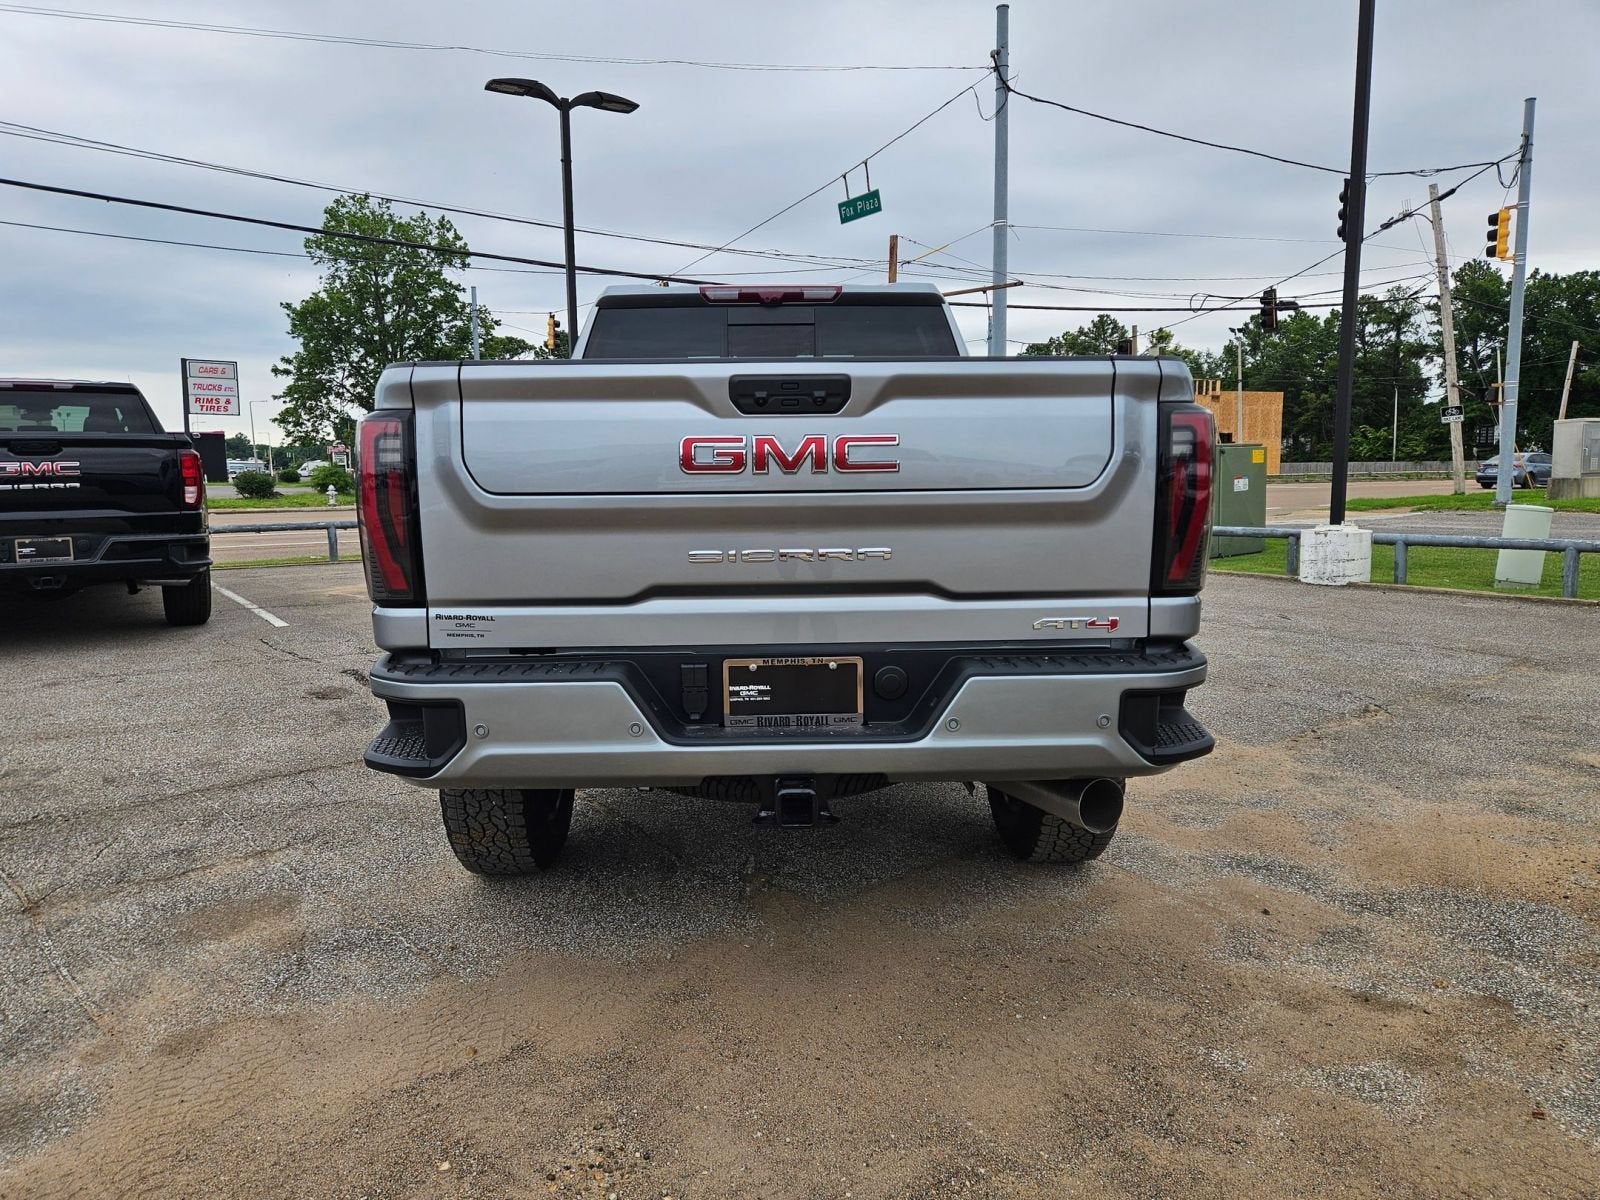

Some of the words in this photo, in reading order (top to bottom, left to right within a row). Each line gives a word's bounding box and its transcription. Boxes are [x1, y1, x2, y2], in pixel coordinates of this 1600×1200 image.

[841, 206, 855, 219] Fox
[856, 198, 879, 214] Plaza
[198, 366, 219, 375] CARS
[192, 383, 223, 392] TRUCKS
[194, 397, 221, 405] RIMS
[199, 405, 229, 413] TIRES
[679, 434, 900, 475] GMC
[0, 461, 81, 476] GMC
[687, 547, 893, 564] SIERRA
[435, 614, 496, 622] RIVARD-ROYALL
[1033, 616, 1120, 633] AT4
[762, 658, 809, 666] MEMPHIS,
[757, 716, 830, 727] RIVARD-ROYALL
